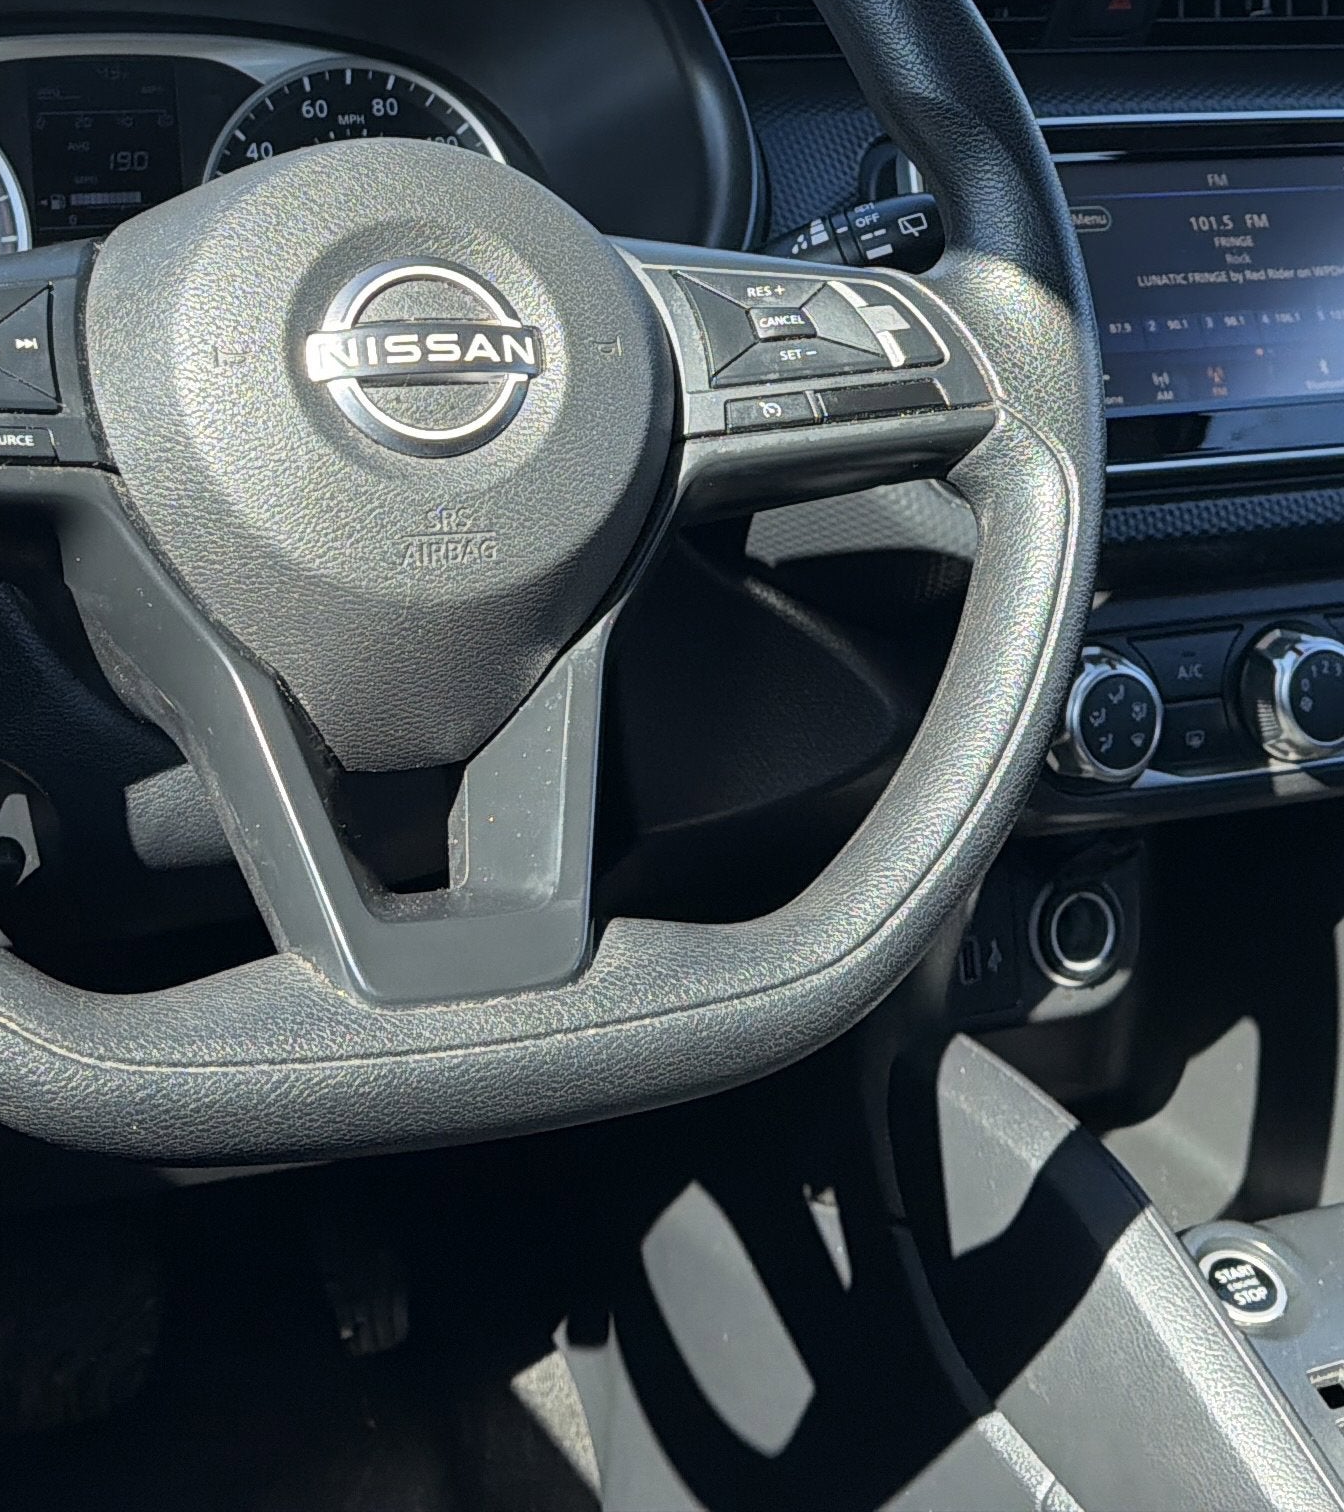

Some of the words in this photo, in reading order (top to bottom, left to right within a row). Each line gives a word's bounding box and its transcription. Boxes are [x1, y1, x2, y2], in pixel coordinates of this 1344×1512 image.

[301, 99, 329, 119] 60
[371, 97, 399, 117] 80
[337, 113, 366, 127] MPH
[245, 141, 274, 160] 40
[1206, 173, 1230, 188] FM
[855, 212, 881, 229] OFF
[1072, 212, 1108, 227] Menu
[1188, 214, 1235, 232] 101.5
[1244, 213, 1271, 230] FM
[1213, 235, 1256, 249] FRINGE
[1136, 273, 1189, 288] LUNATIC
[1188, 270, 1229, 284] FRINGE
[1230, 269, 1245, 284] by
[746, 285, 772, 298] RES
[759, 314, 806, 328] CANCEL
[319, 332, 537, 368] NISSAN
[779, 348, 803, 362] SET
[425, 507, 473, 533] SRS
[401, 539, 498, 569] AIRBAG
[1176, 663, 1204, 681] A/C
[1321, 659, 1331, 674] 2
[1214, 1264, 1257, 1285] START
[1233, 1286, 1269, 1306] STOP
